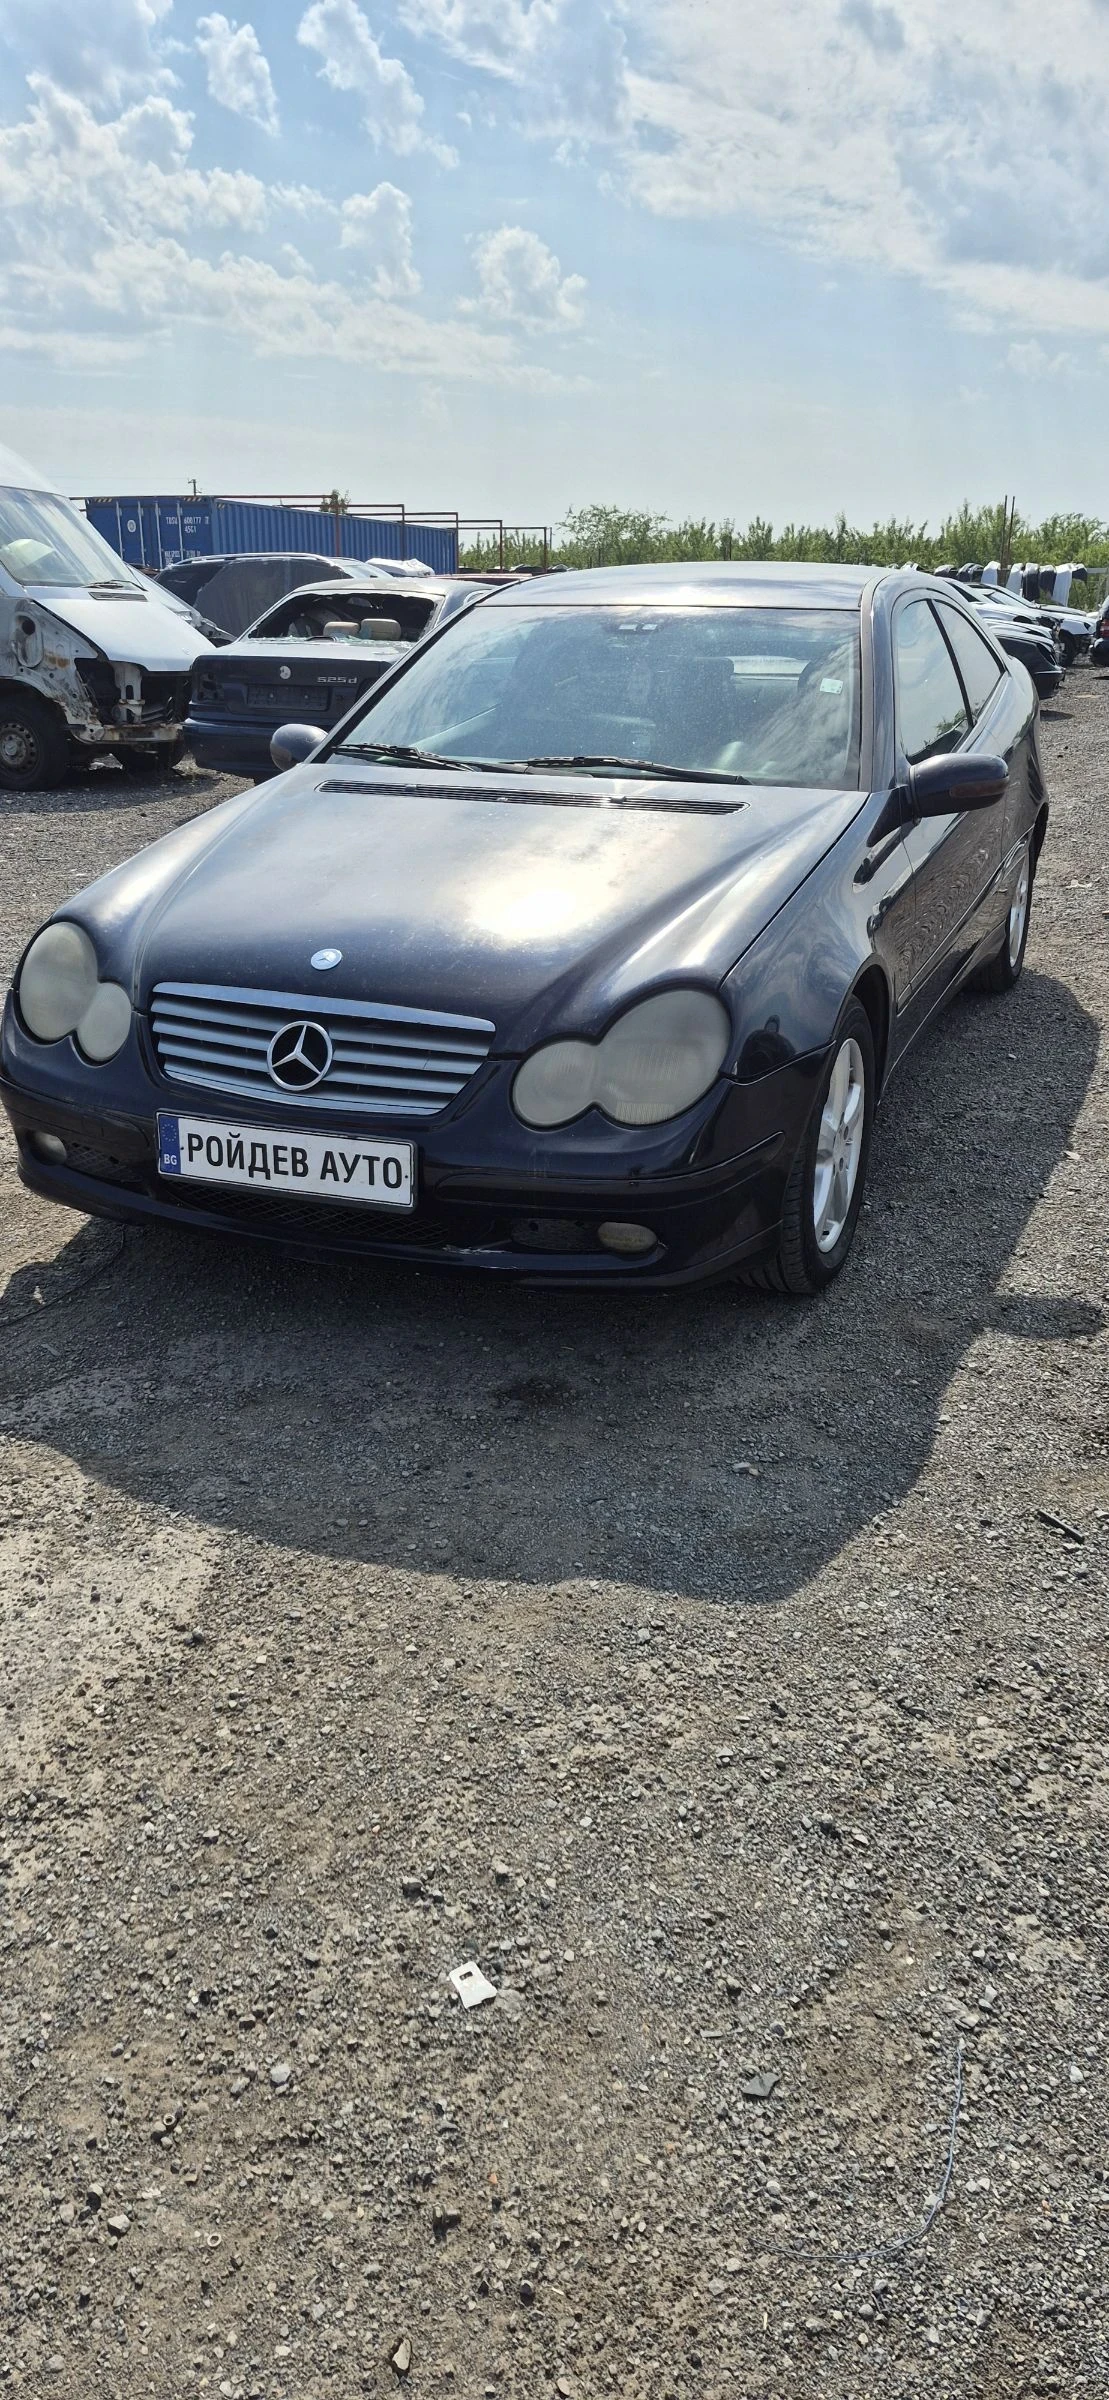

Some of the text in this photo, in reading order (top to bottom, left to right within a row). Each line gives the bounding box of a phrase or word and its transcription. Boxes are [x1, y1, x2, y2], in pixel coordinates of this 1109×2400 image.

[317, 676, 358, 685] 525d
[163, 1153, 178, 1166] BG
[187, 1131, 402, 1189] РОЙДЕВ АУТО
